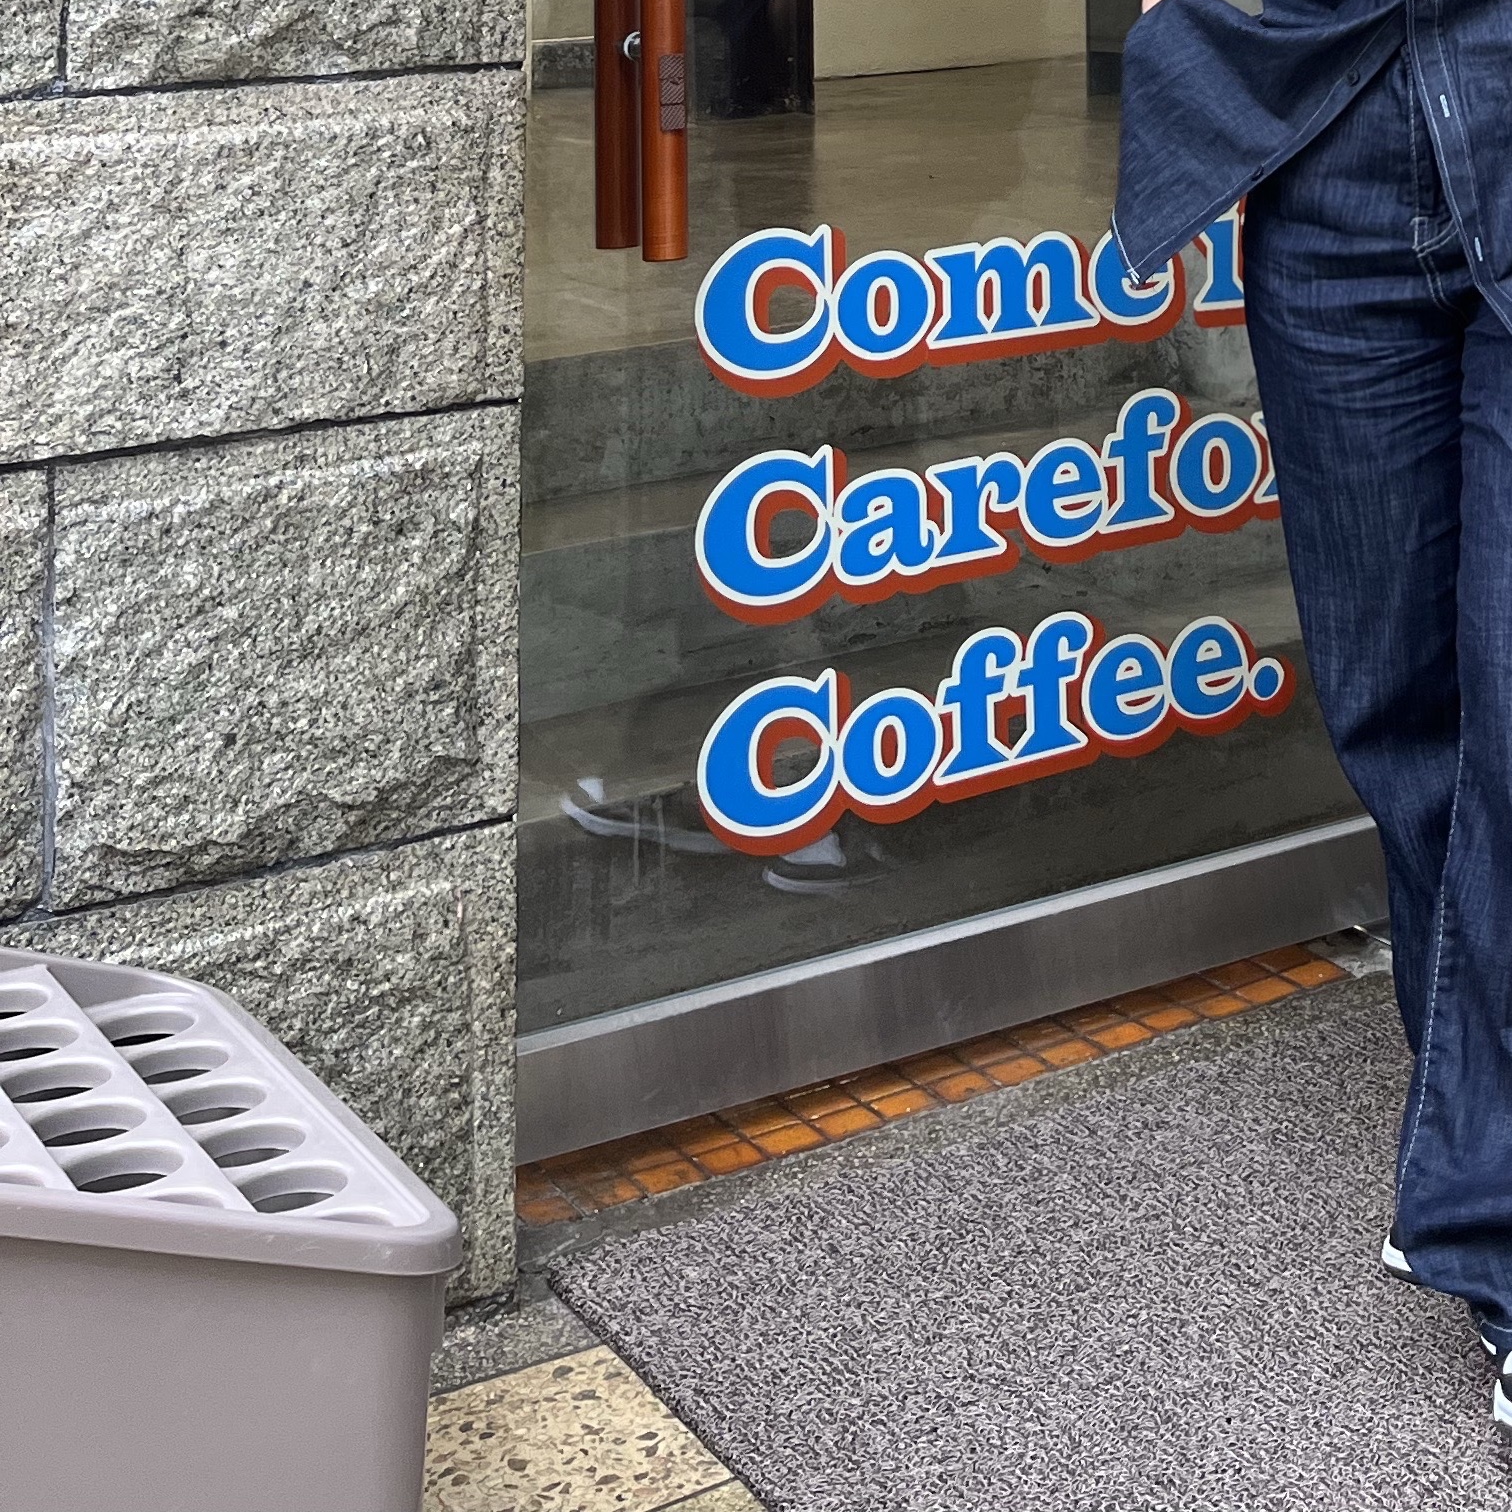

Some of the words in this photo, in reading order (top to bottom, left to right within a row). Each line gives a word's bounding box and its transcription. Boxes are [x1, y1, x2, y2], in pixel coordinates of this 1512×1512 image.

[695, 223, 1182, 388] Come
[695, 386, 1279, 613] Carefo
[696, 610, 1290, 843] Coffee.
